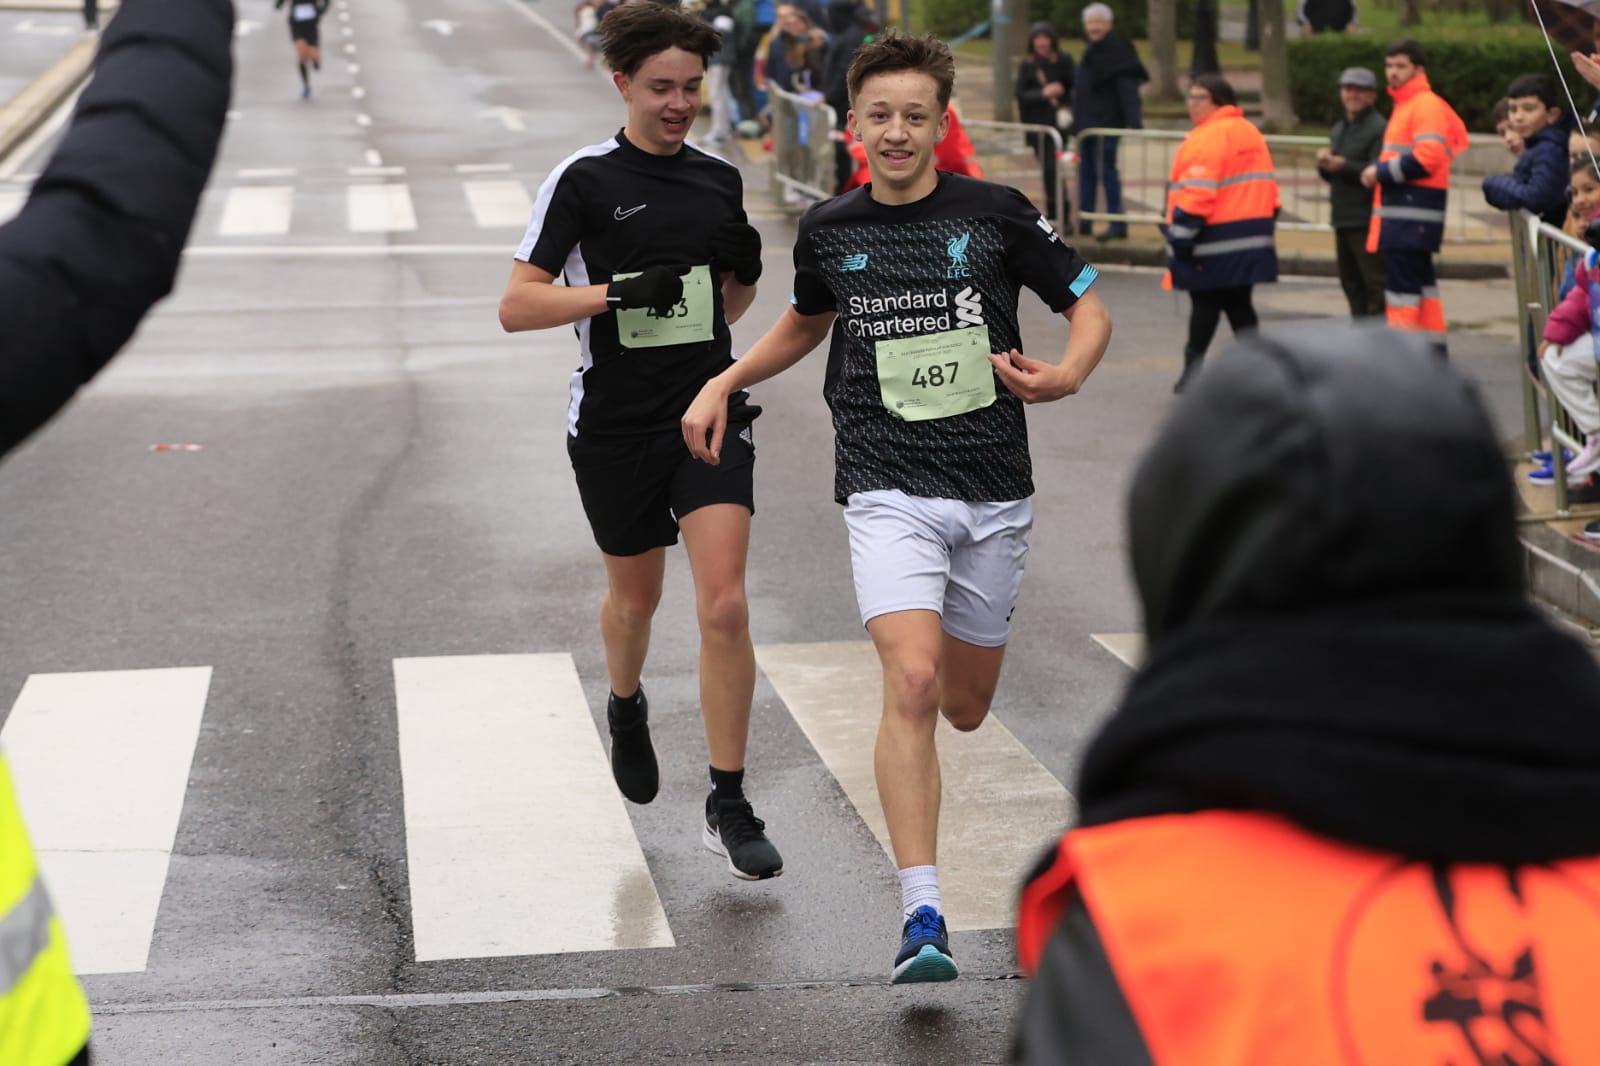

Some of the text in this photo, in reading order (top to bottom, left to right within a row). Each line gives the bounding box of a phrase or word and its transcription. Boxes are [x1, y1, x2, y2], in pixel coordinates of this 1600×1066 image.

[849, 288, 948, 315] Standard
[848, 312, 950, 337] Chartered
[912, 361, 959, 389] 487
